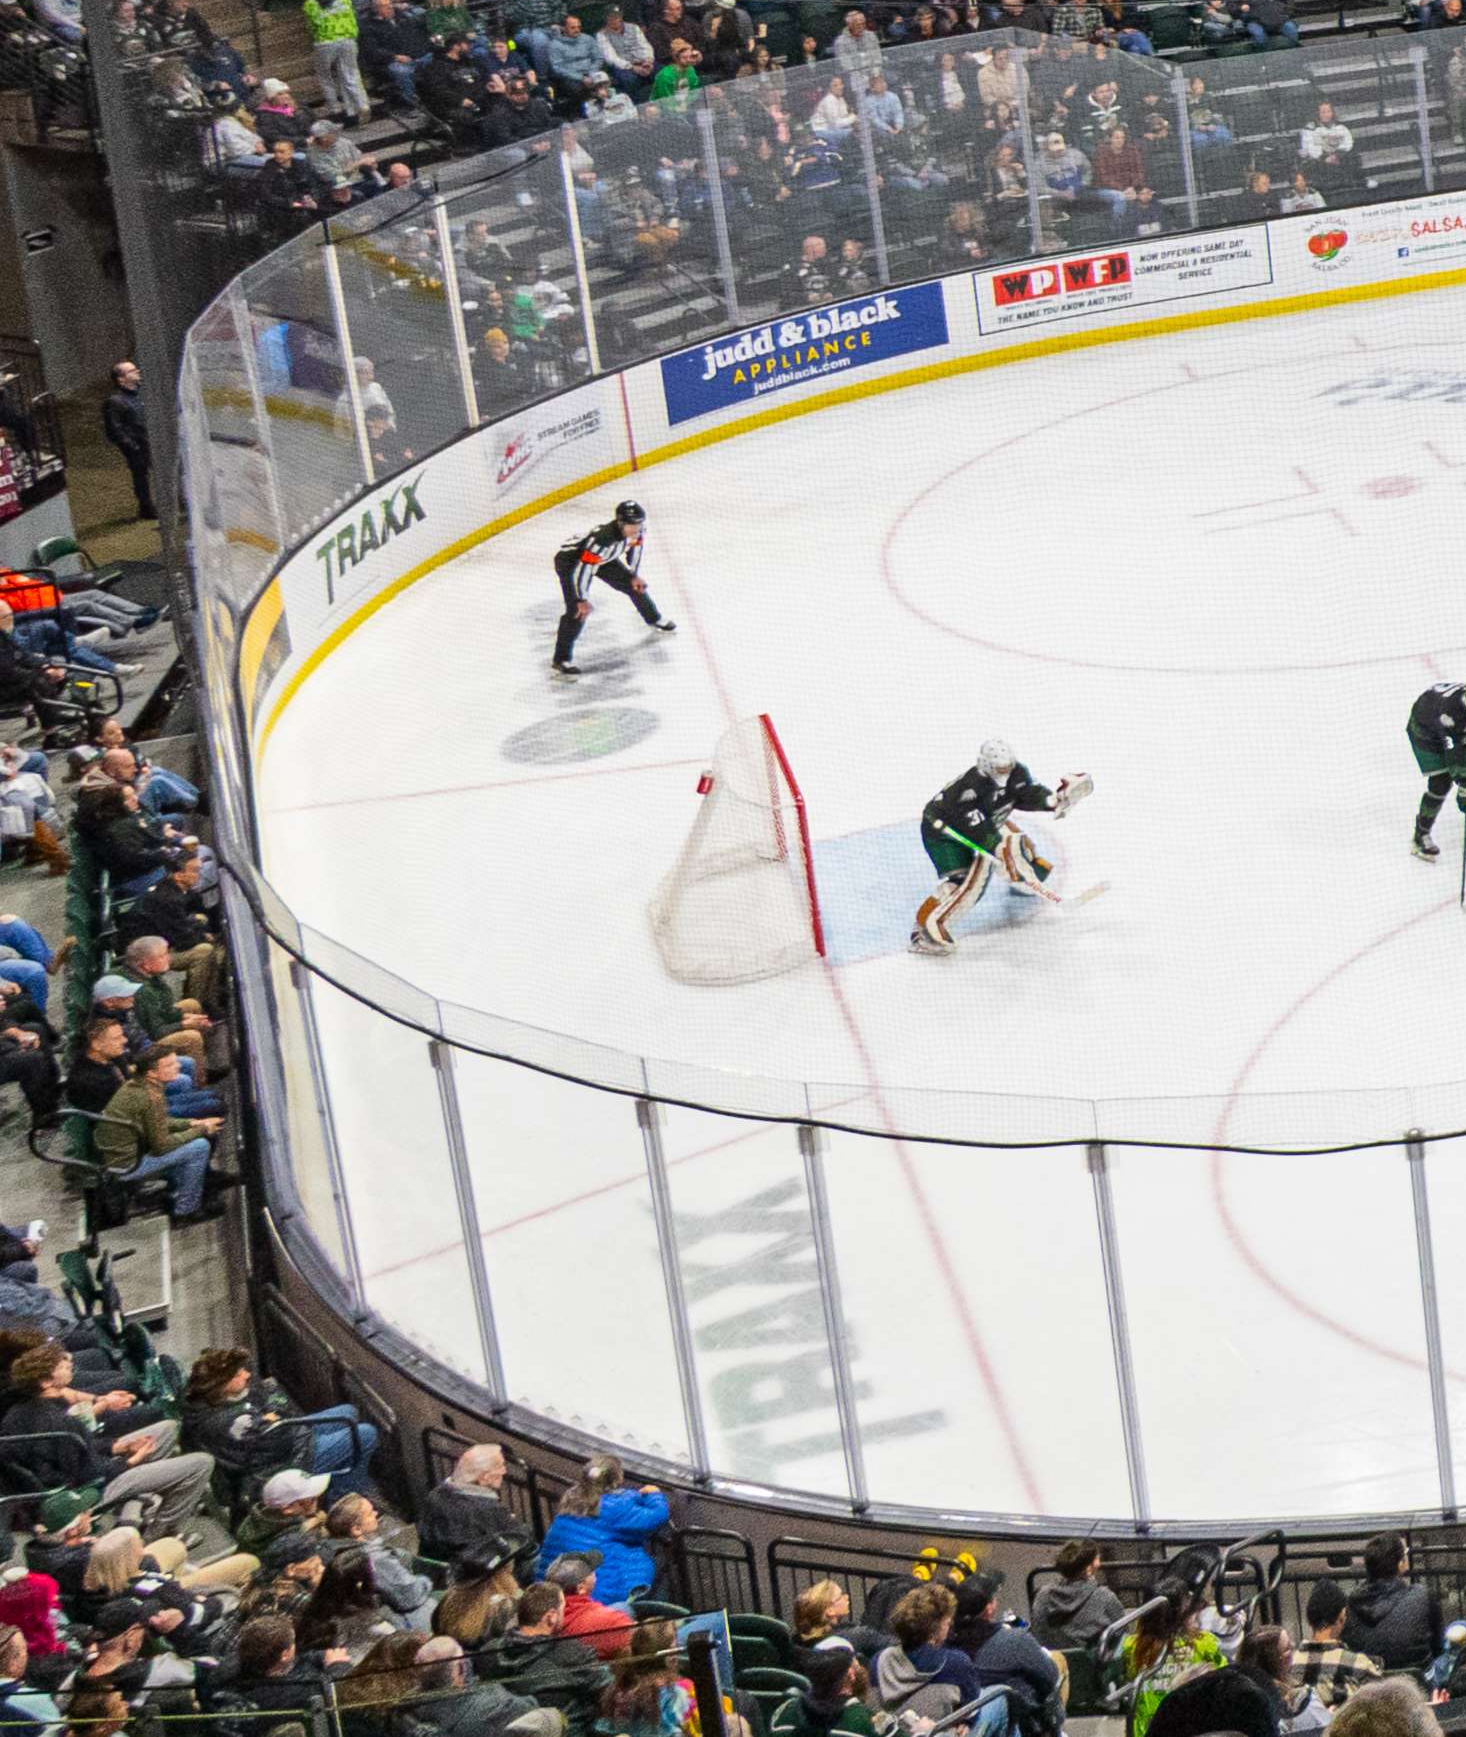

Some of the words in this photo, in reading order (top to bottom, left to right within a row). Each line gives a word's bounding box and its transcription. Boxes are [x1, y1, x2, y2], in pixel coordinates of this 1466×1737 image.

[1001, 270, 1055, 296] WP
[702, 331, 775, 379] judd
[778, 322, 804, 348] &
[801, 294, 901, 343] black
[733, 329, 872, 385] APPLIANCE
[753, 355, 852, 395] juddblack.com
[316, 468, 427, 605] TRAXX
